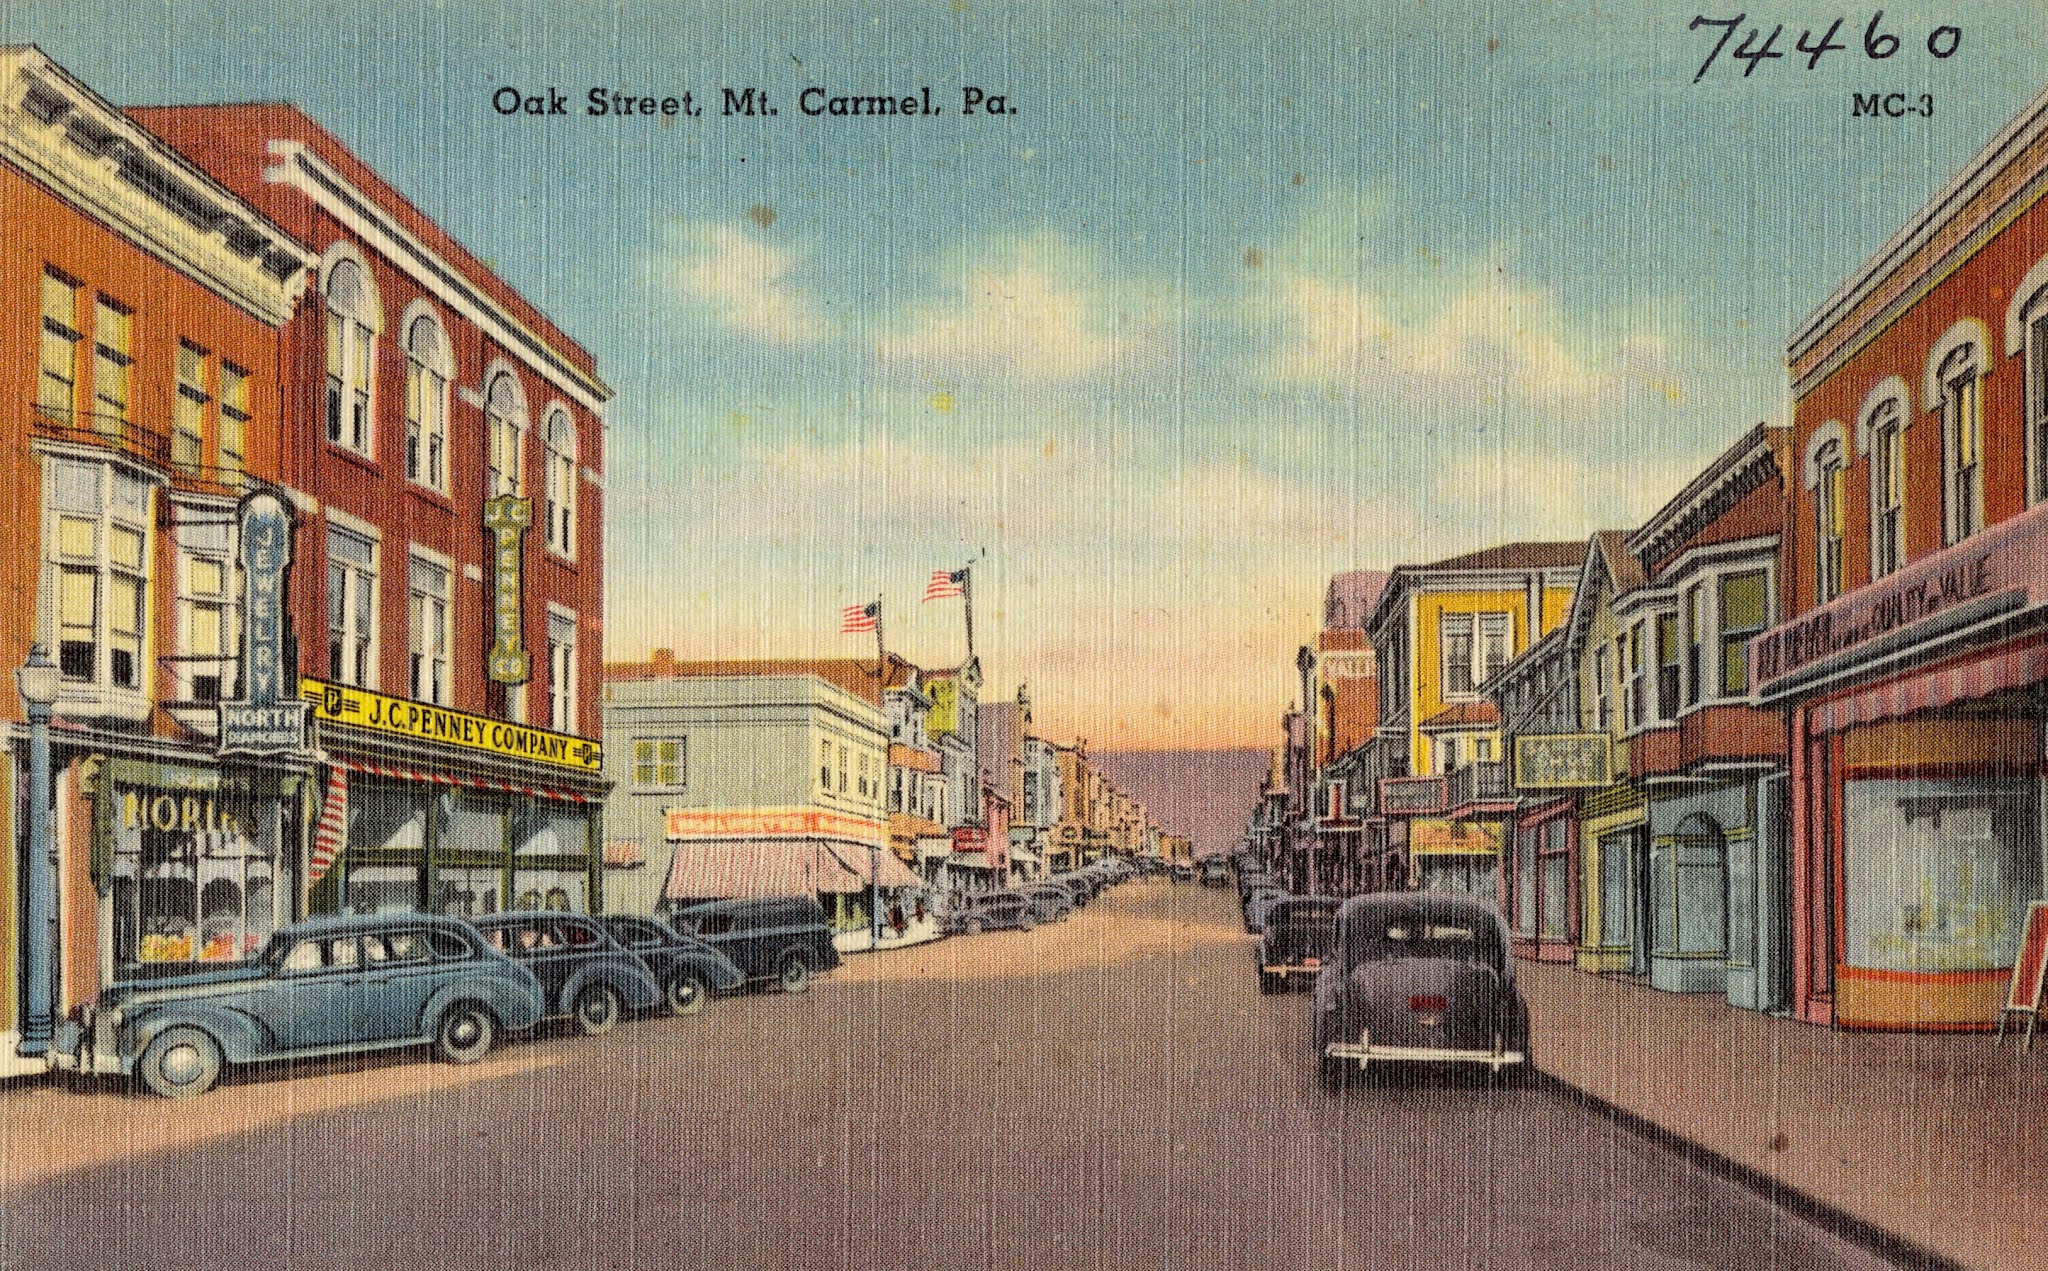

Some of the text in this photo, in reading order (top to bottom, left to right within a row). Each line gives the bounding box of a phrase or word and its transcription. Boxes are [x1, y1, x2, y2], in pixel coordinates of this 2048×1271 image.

[1689, 10, 1961, 83] 74460
[255, 526, 275, 694] JEWELRY
[227, 709, 299, 728] NORTH
[492, 725, 568, 760] COMPANY
